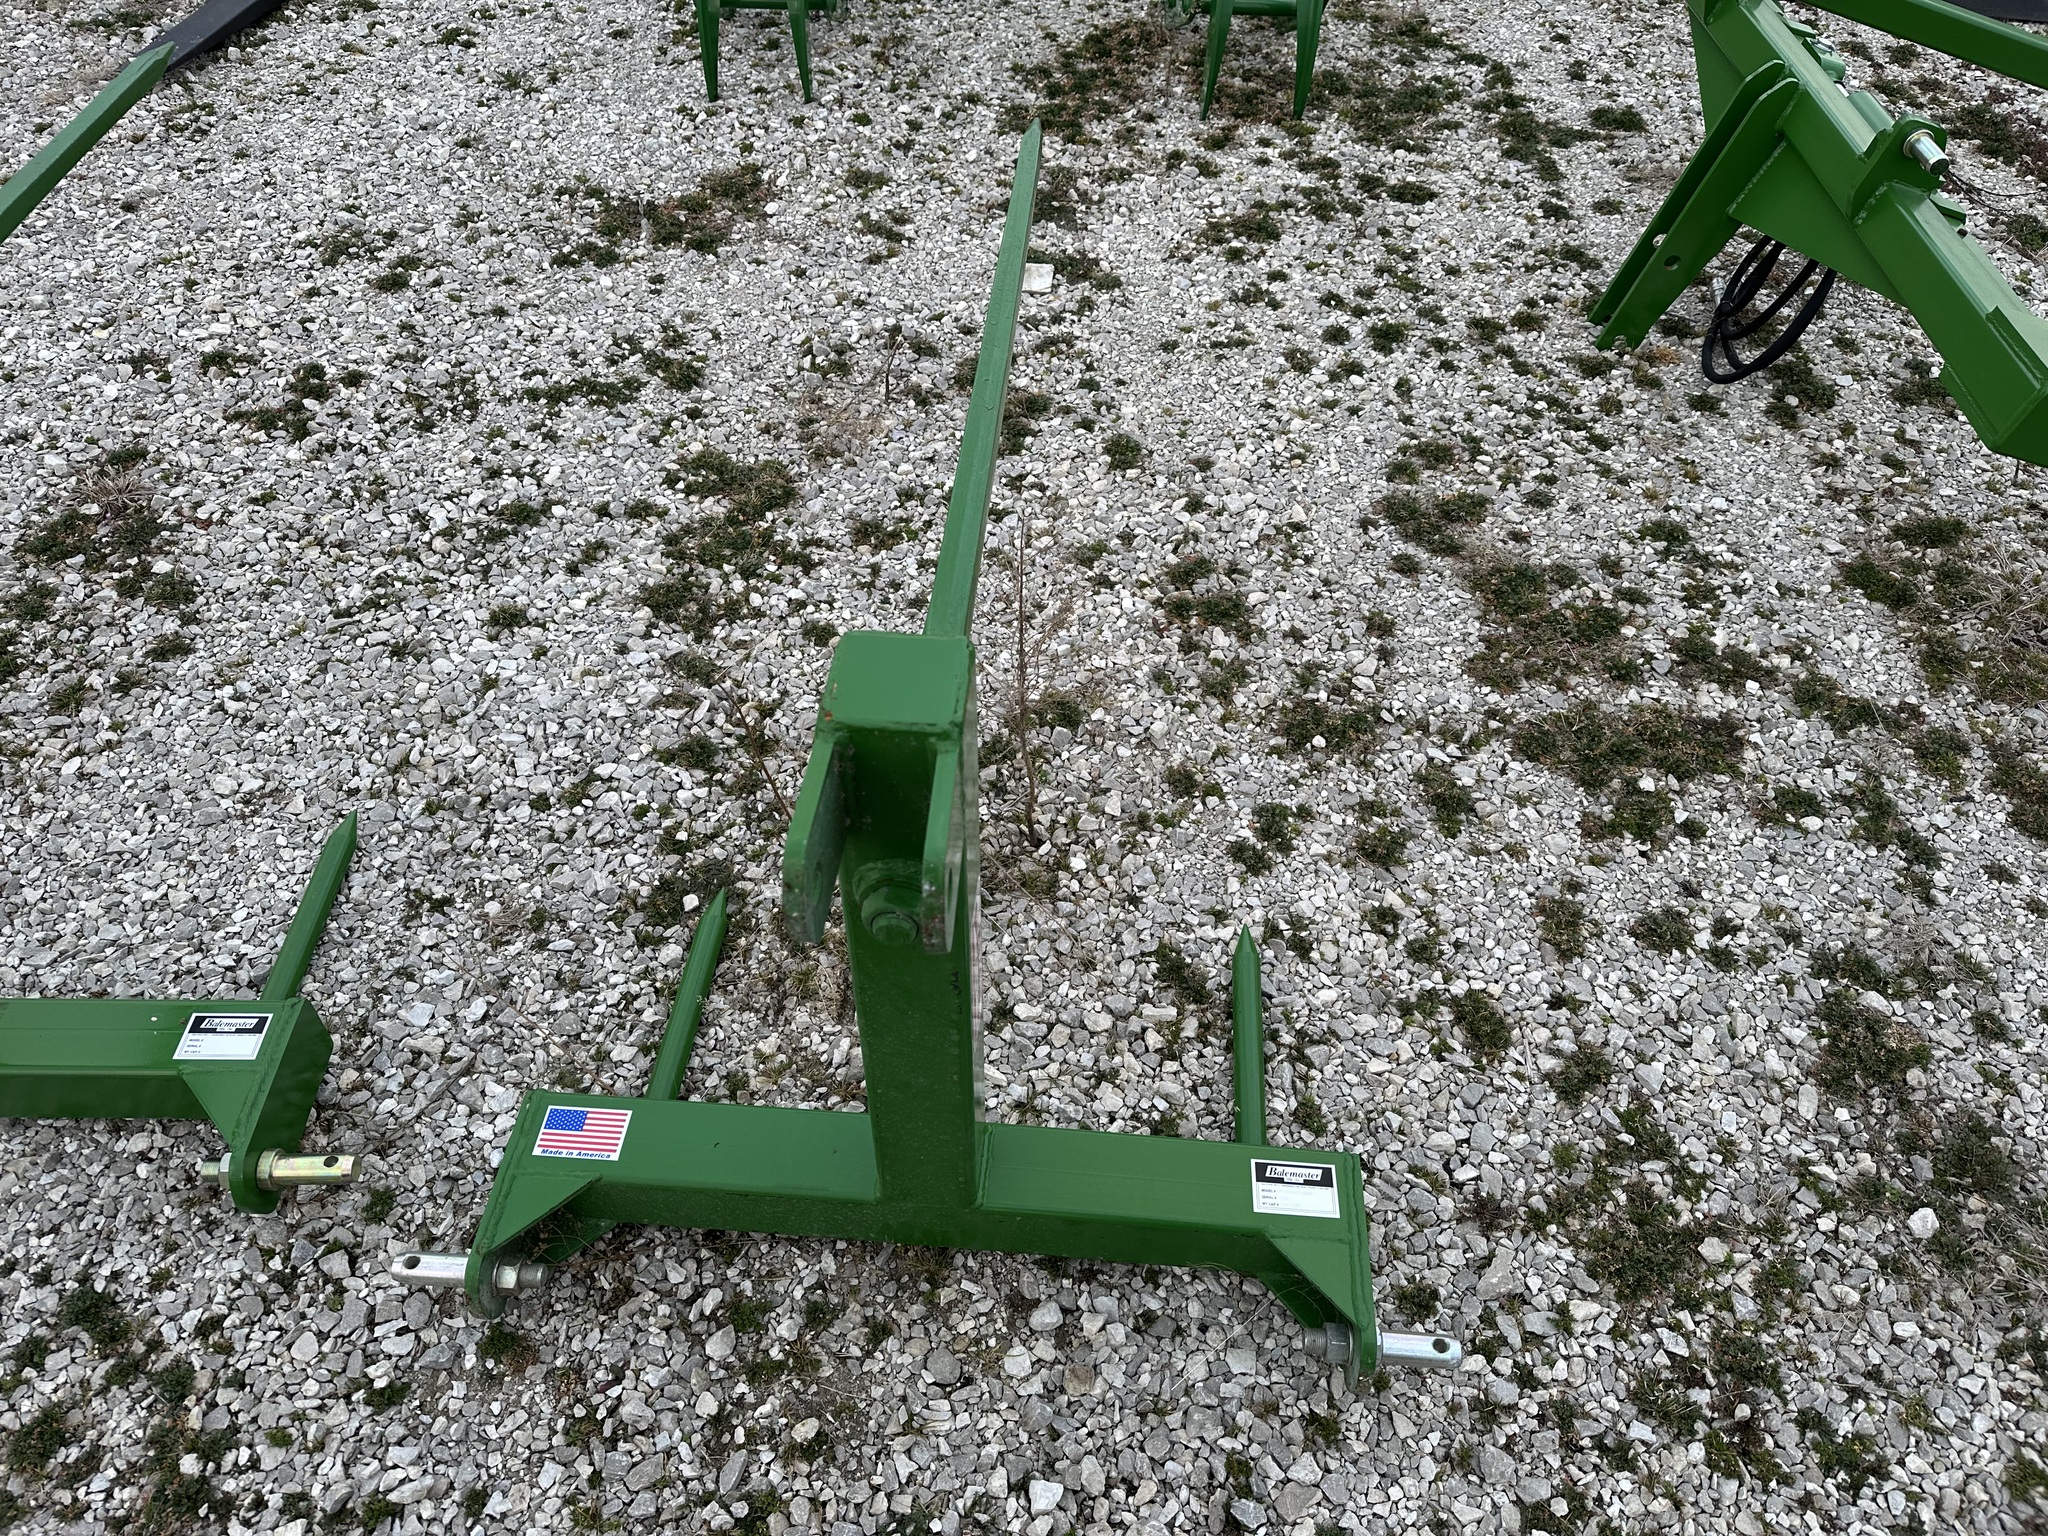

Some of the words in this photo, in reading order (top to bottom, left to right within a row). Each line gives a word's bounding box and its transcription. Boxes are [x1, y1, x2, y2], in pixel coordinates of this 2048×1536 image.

[203, 1018, 255, 1028] Balemaster
[540, 1148, 563, 1156] Made
[575, 1151, 611, 1159] America
[1268, 1166, 1320, 1180] Balemaster
